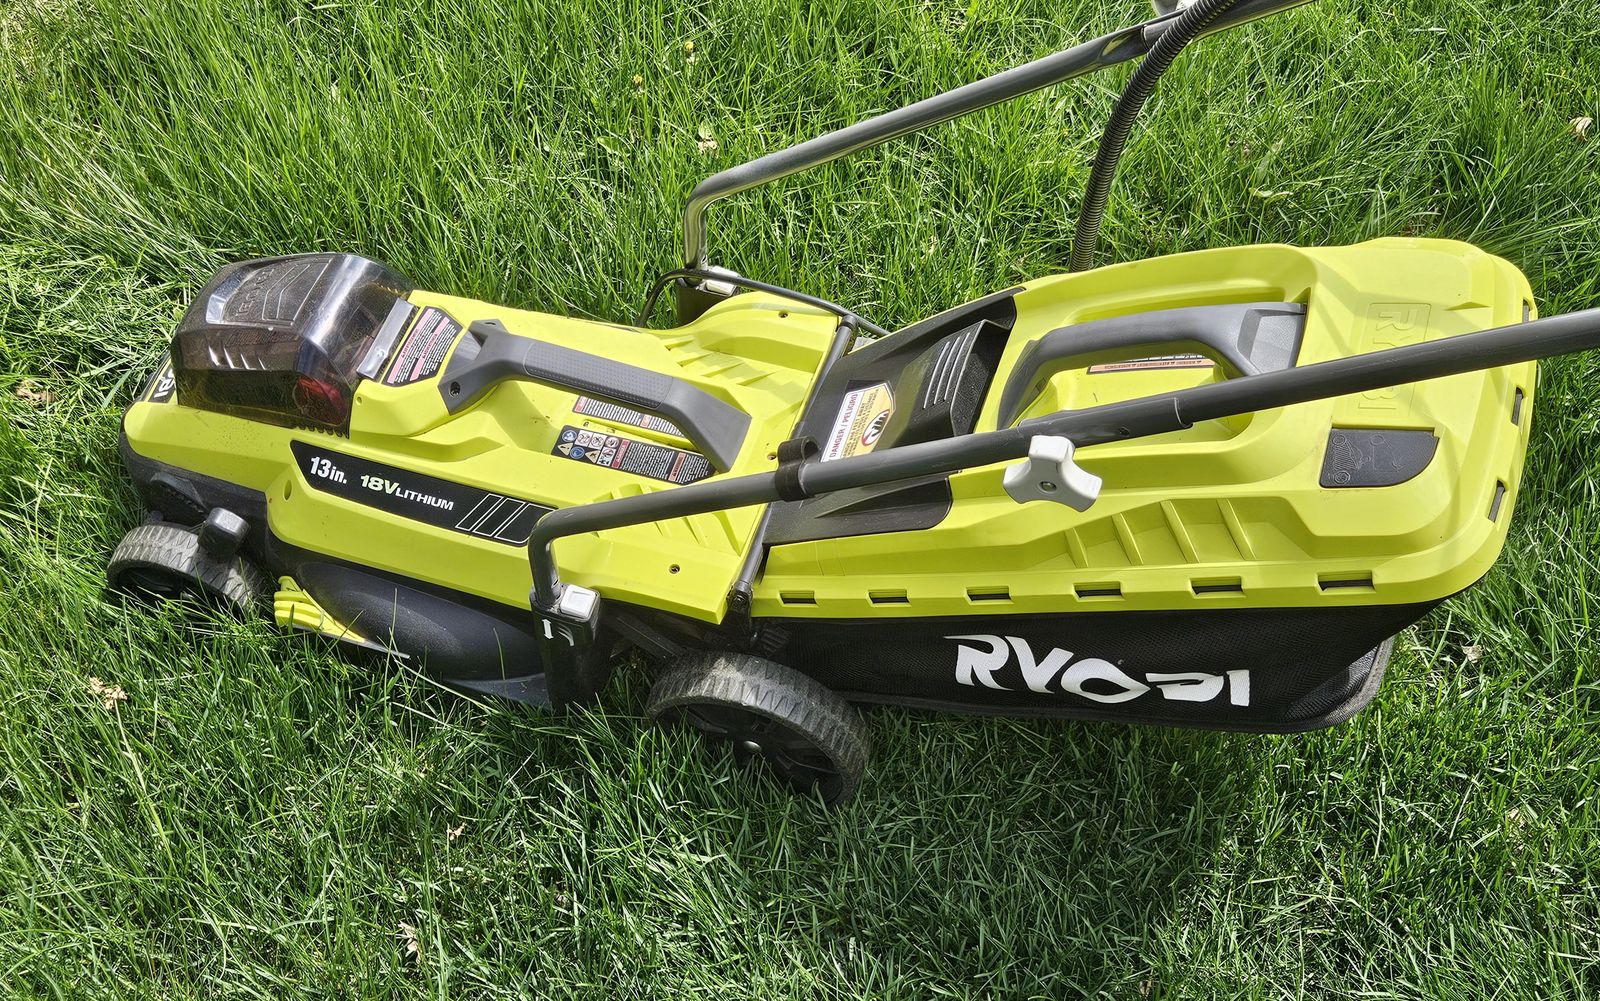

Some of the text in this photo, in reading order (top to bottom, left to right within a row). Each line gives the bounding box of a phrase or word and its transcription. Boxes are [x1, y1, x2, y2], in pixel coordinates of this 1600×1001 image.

[829, 428, 845, 458] DANGER
[311, 456, 347, 484] 13in.
[943, 634, 1250, 707] RYOBI
